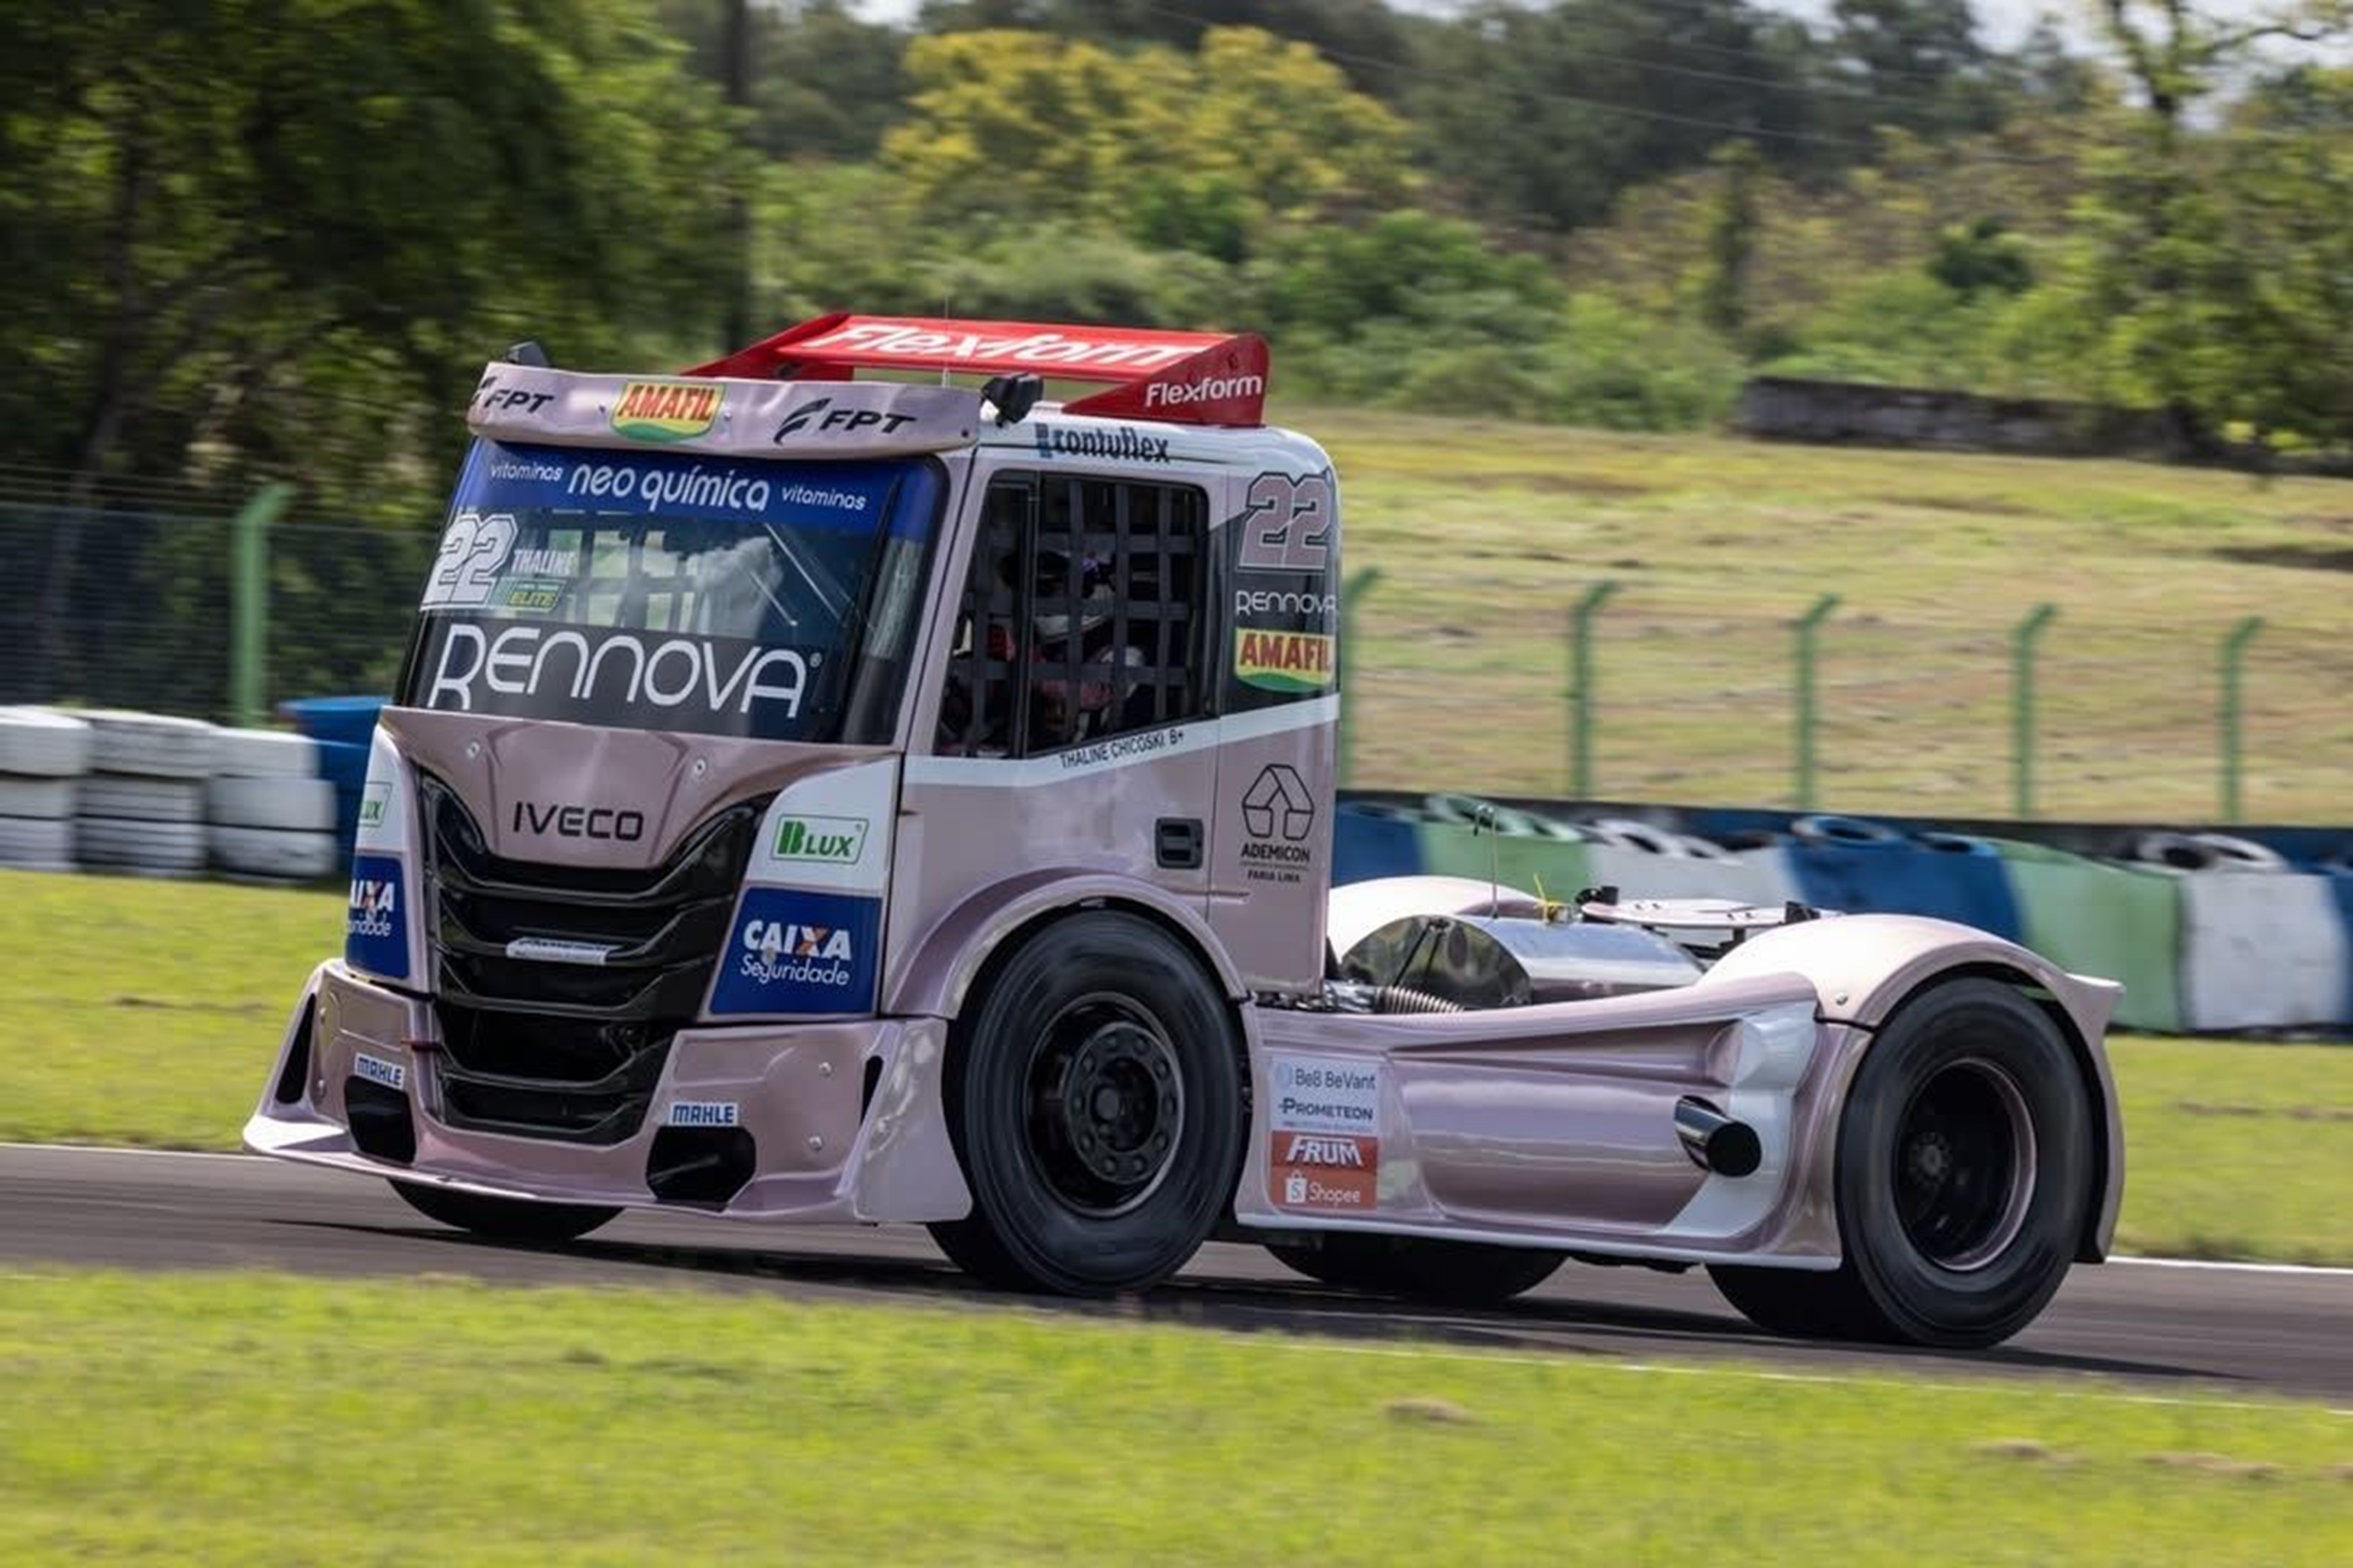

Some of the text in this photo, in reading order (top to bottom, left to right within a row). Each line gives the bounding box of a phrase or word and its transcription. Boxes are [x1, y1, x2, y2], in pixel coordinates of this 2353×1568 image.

[801, 324, 1207, 366] Flexform
[484, 390, 554, 414] FPT
[617, 385, 716, 421] AMAFIL
[1145, 375, 1261, 408] Flexform
[819, 410, 918, 433] FPT
[490, 462, 562, 480] vitaminas
[568, 464, 770, 512] neo química
[782, 486, 867, 511] vitaminas
[1238, 471, 1334, 572] 22
[419, 513, 519, 611] 22
[511, 549, 574, 577] THALINE
[1239, 632, 1332, 671] AMAFIL
[1060, 745, 1109, 768] THALINE
[1110, 732, 1165, 758] CHICOSKI
[513, 801, 644, 842] IVECO
[1241, 842, 1310, 862] ADEMICON
[743, 920, 852, 961] CAIXA
[740, 953, 850, 985] Seguridade
[357, 1057, 402, 1086] MAHLE
[1295, 1069, 1376, 1090] Be8 BeVant
[673, 1104, 734, 1123] MAHLE
[1280, 1098, 1374, 1121] PROMETEON
[1287, 1136, 1364, 1167] FRUM
[1309, 1182, 1361, 1204] Shopee
